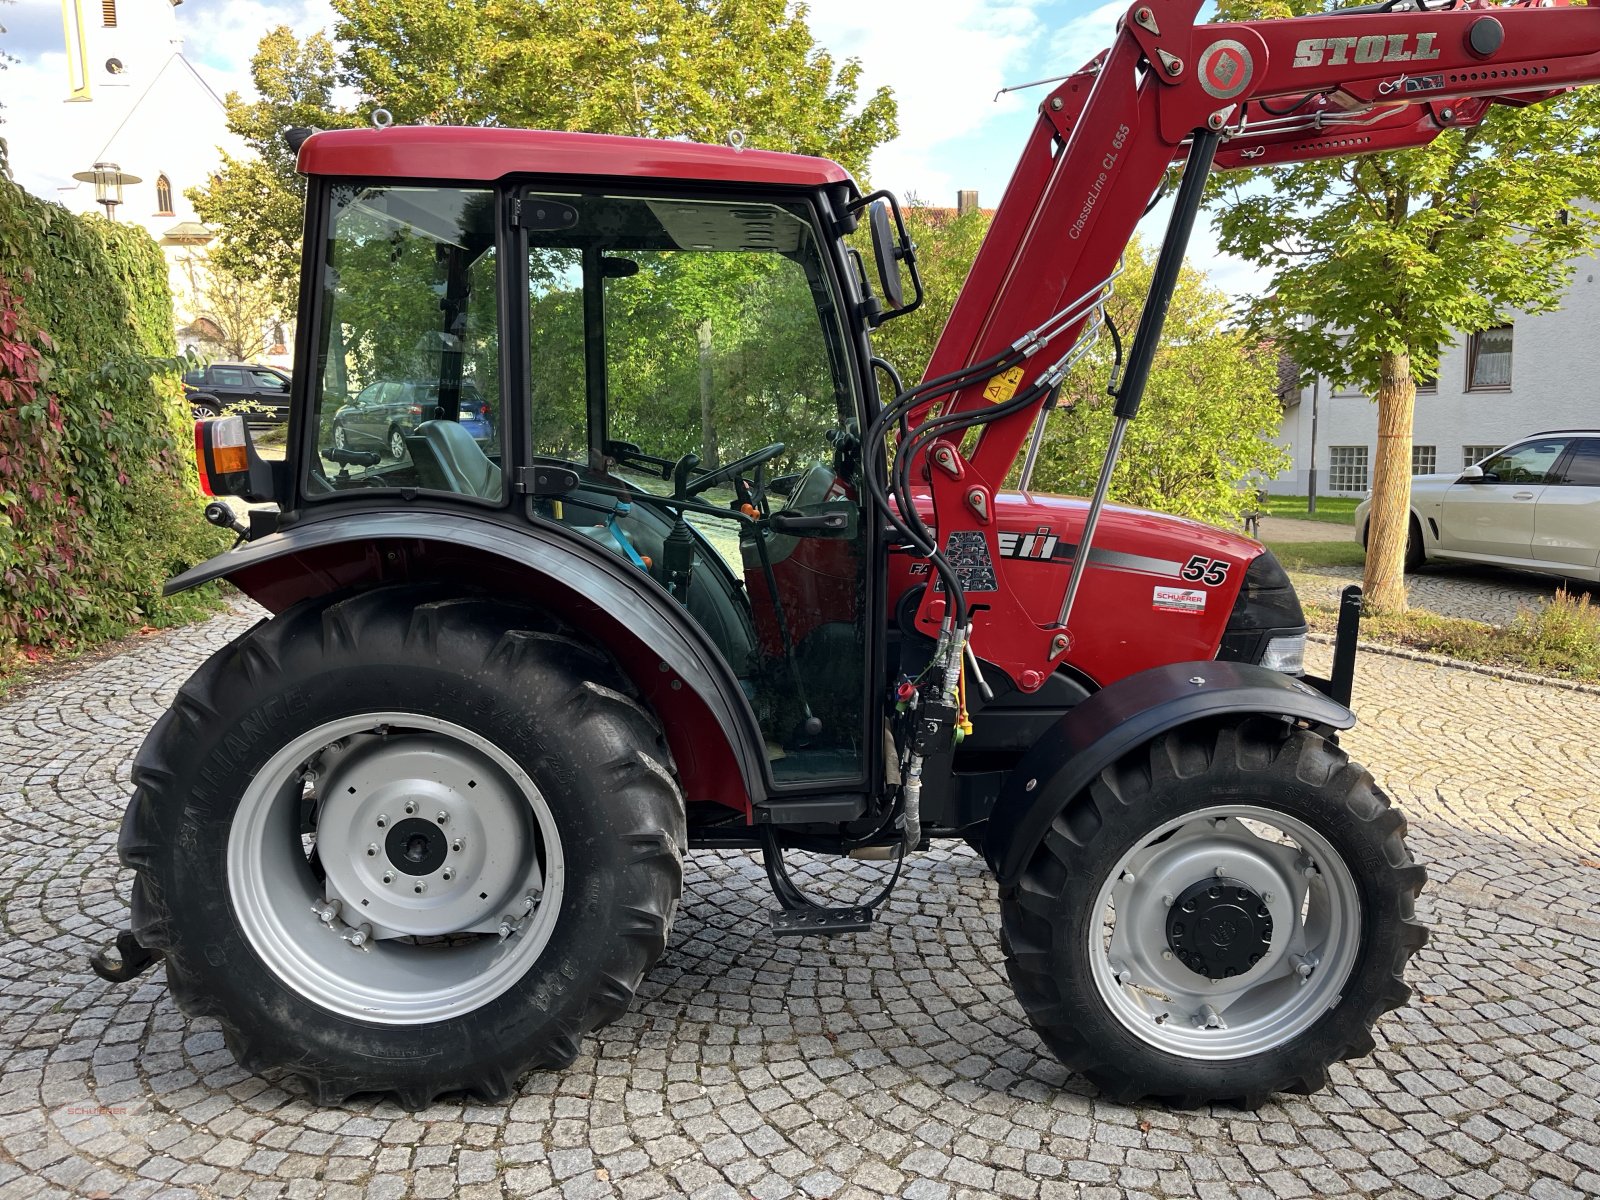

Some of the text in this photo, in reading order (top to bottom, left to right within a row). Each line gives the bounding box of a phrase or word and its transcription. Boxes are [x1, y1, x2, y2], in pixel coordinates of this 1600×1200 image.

[1292, 32, 1441, 68] STOLL
[1068, 123, 1130, 240] ClassicLine CL 655
[909, 562, 930, 575] FA
[1181, 554, 1232, 587] 55
[183, 686, 310, 826] ALLIANCE
